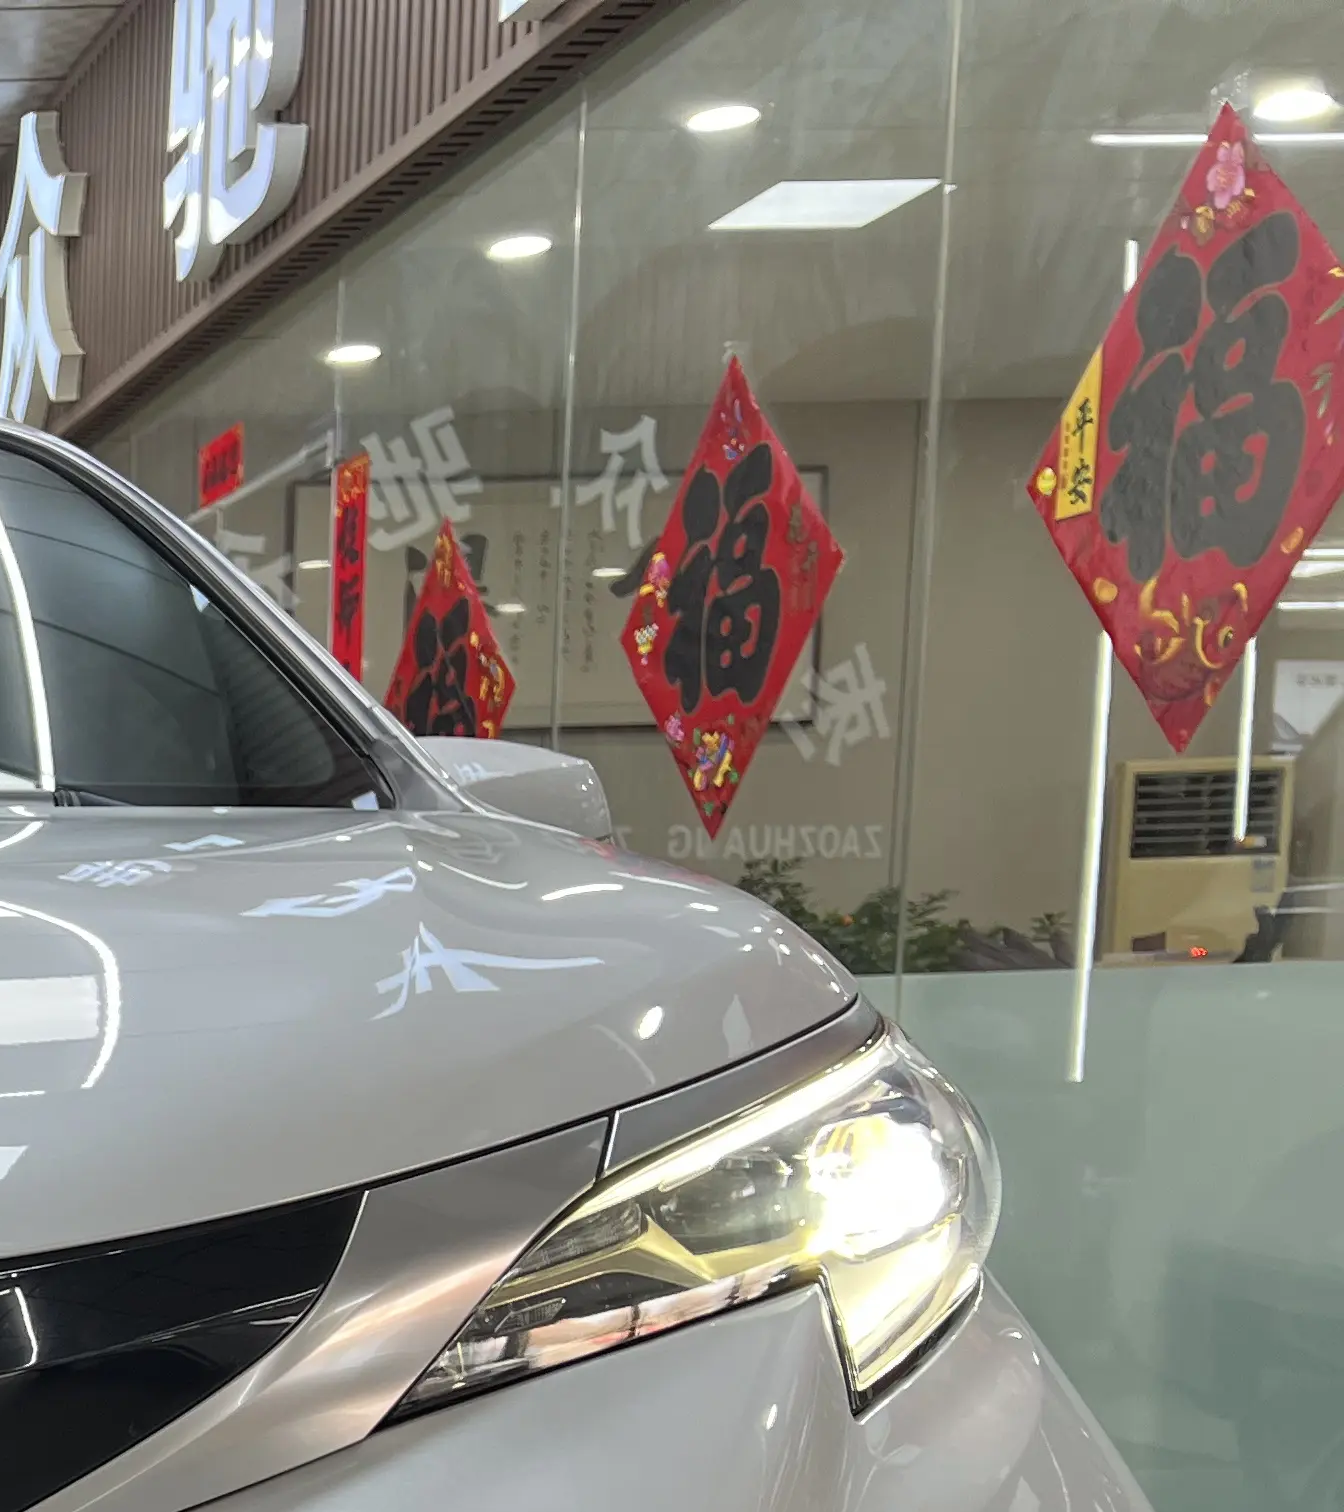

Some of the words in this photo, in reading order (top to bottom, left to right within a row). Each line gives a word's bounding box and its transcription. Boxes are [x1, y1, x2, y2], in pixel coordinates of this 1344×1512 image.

[1071, 397, 1094, 505] 平安
[1100, 210, 1306, 584] 福
[664, 443, 782, 714] 福
